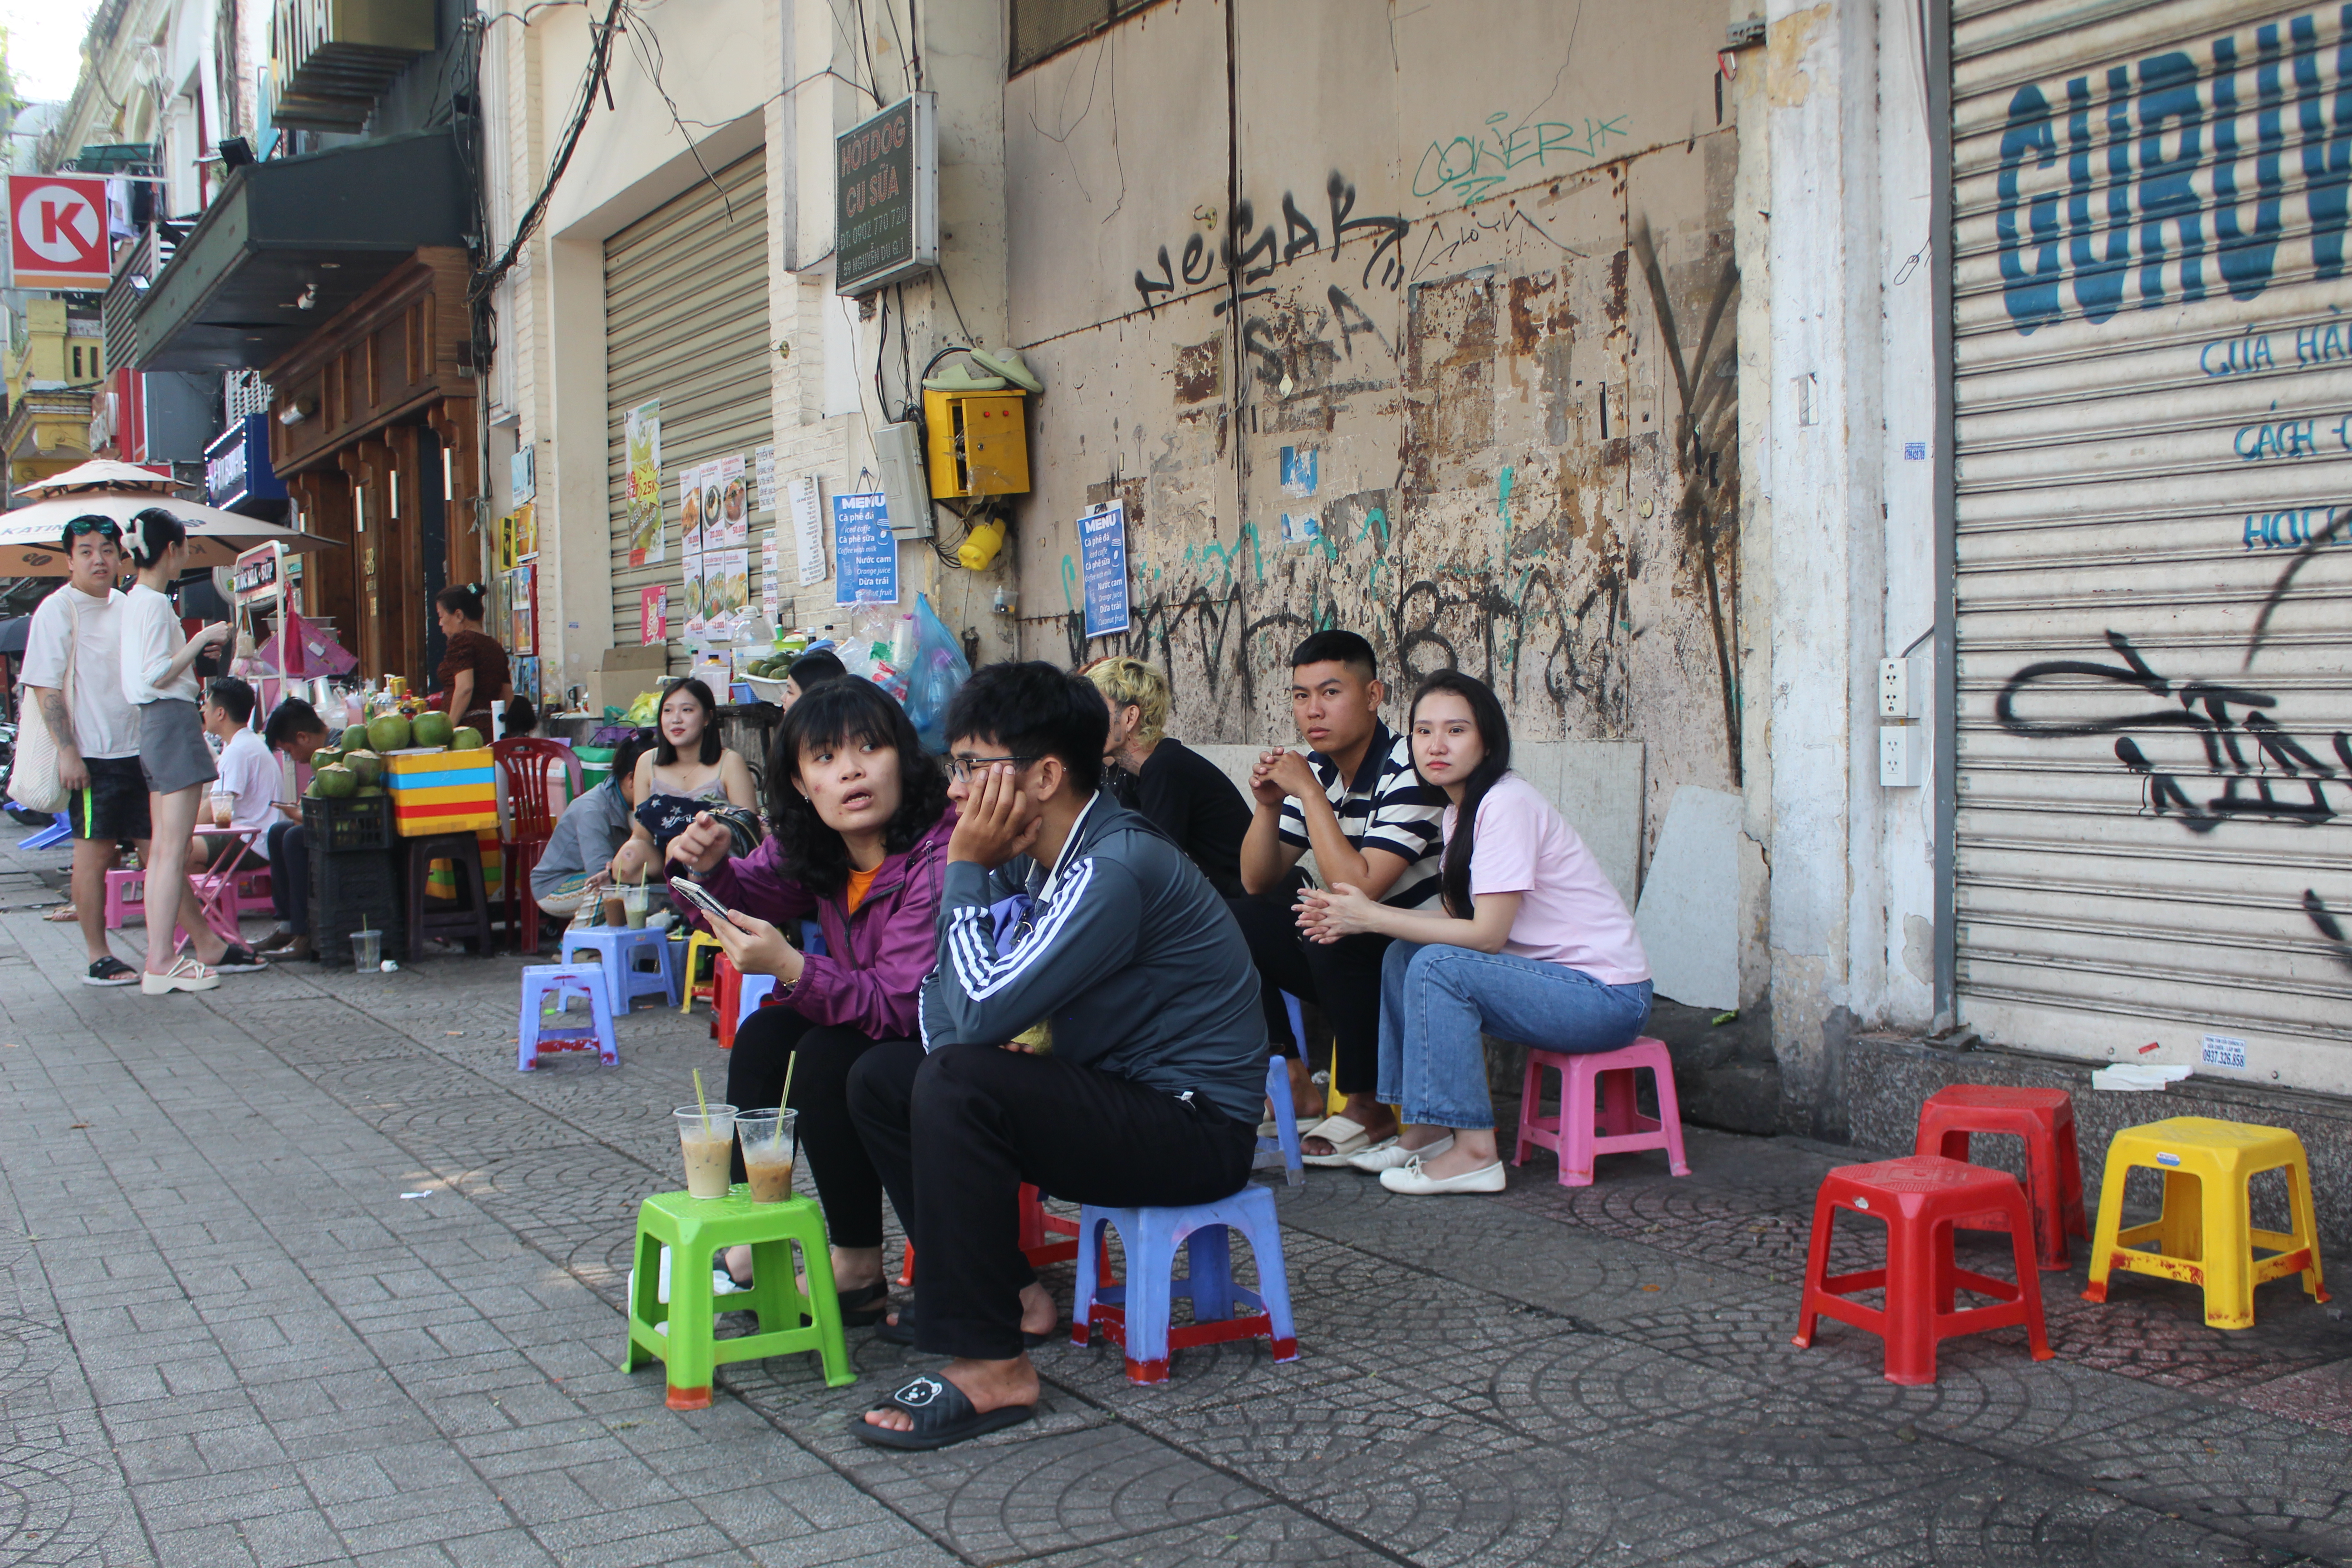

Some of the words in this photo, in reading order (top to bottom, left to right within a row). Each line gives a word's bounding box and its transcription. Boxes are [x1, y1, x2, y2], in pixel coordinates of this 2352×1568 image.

[41, 201, 93, 258] K
[853, 221, 871, 245] 0902
[874, 213, 888, 235] 770
[891, 206, 906, 228] 720
[2297, 304, 2352, 368] HÀ
[643, 480, 656, 496] 25K
[842, 495, 885, 509] MENU
[839, 514, 848, 522] Cà
[850, 512, 863, 523] phê
[733, 524, 745, 534] 50.000
[857, 524, 871, 534] coffe
[1085, 513, 1116, 534] MENU
[710, 529, 723, 539] 20.000
[849, 534, 861, 545] phê
[1084, 538, 1091, 547] Cà
[1093, 534, 1102, 547] phê
[1103, 532, 1109, 542] đá
[838, 547, 853, 555] Coffee
[1089, 550, 1098, 559] iced
[856, 556, 874, 564] Nước
[1085, 562, 1091, 570] Cà
[1093, 559, 1101, 571] phê
[1102, 558, 1110, 566] sữa
[859, 578, 873, 586] Dừa
[1085, 573, 1096, 583] Coffee
[1098, 581, 1111, 590] Nước
[1111, 579, 1122, 587] cam
[879, 589, 892, 598] fruit
[1098, 594, 1112, 602] Orange
[1112, 591, 1122, 600] juice
[1100, 604, 1110, 613] Dừa
[1111, 601, 1121, 610] trái
[1098, 617, 1114, 626] Coconut
[1114, 614, 1124, 624] fruit
